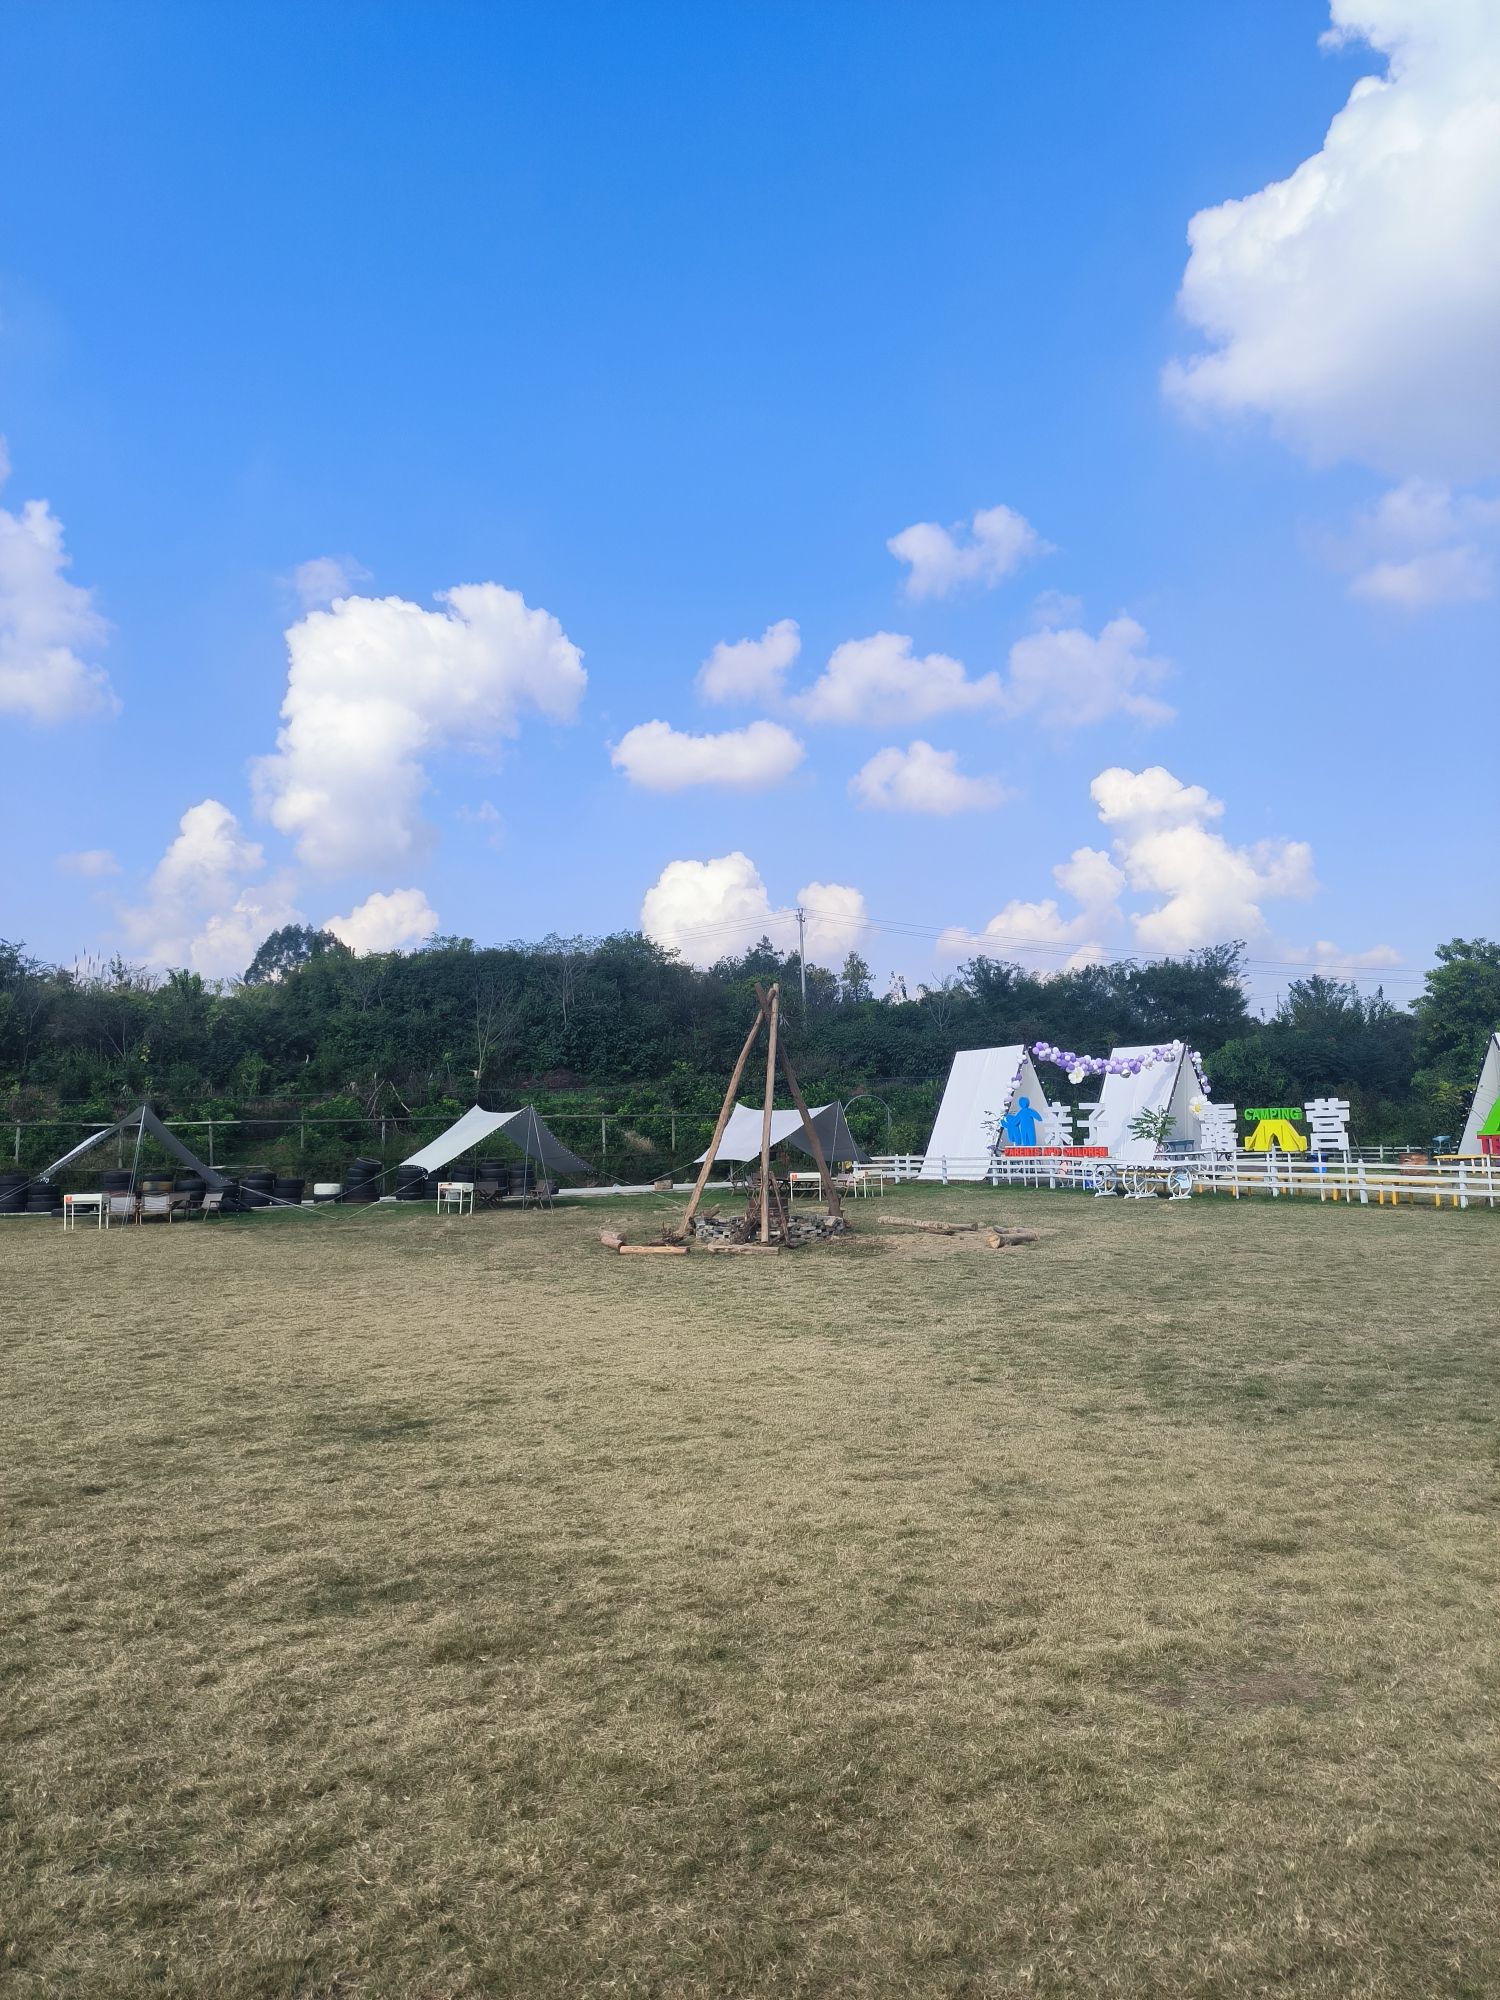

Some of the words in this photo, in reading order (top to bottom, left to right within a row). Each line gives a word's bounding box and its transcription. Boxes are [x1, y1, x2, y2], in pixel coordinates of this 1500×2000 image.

[1244, 1107, 1302, 1120] CAMPING
[1043, 1102, 1109, 1146] 亲子
[1004, 1147, 1042, 1157] PARENTS
[1043, 1147, 1062, 1157] AND
[1064, 1147, 1108, 1157] CHILDREN
